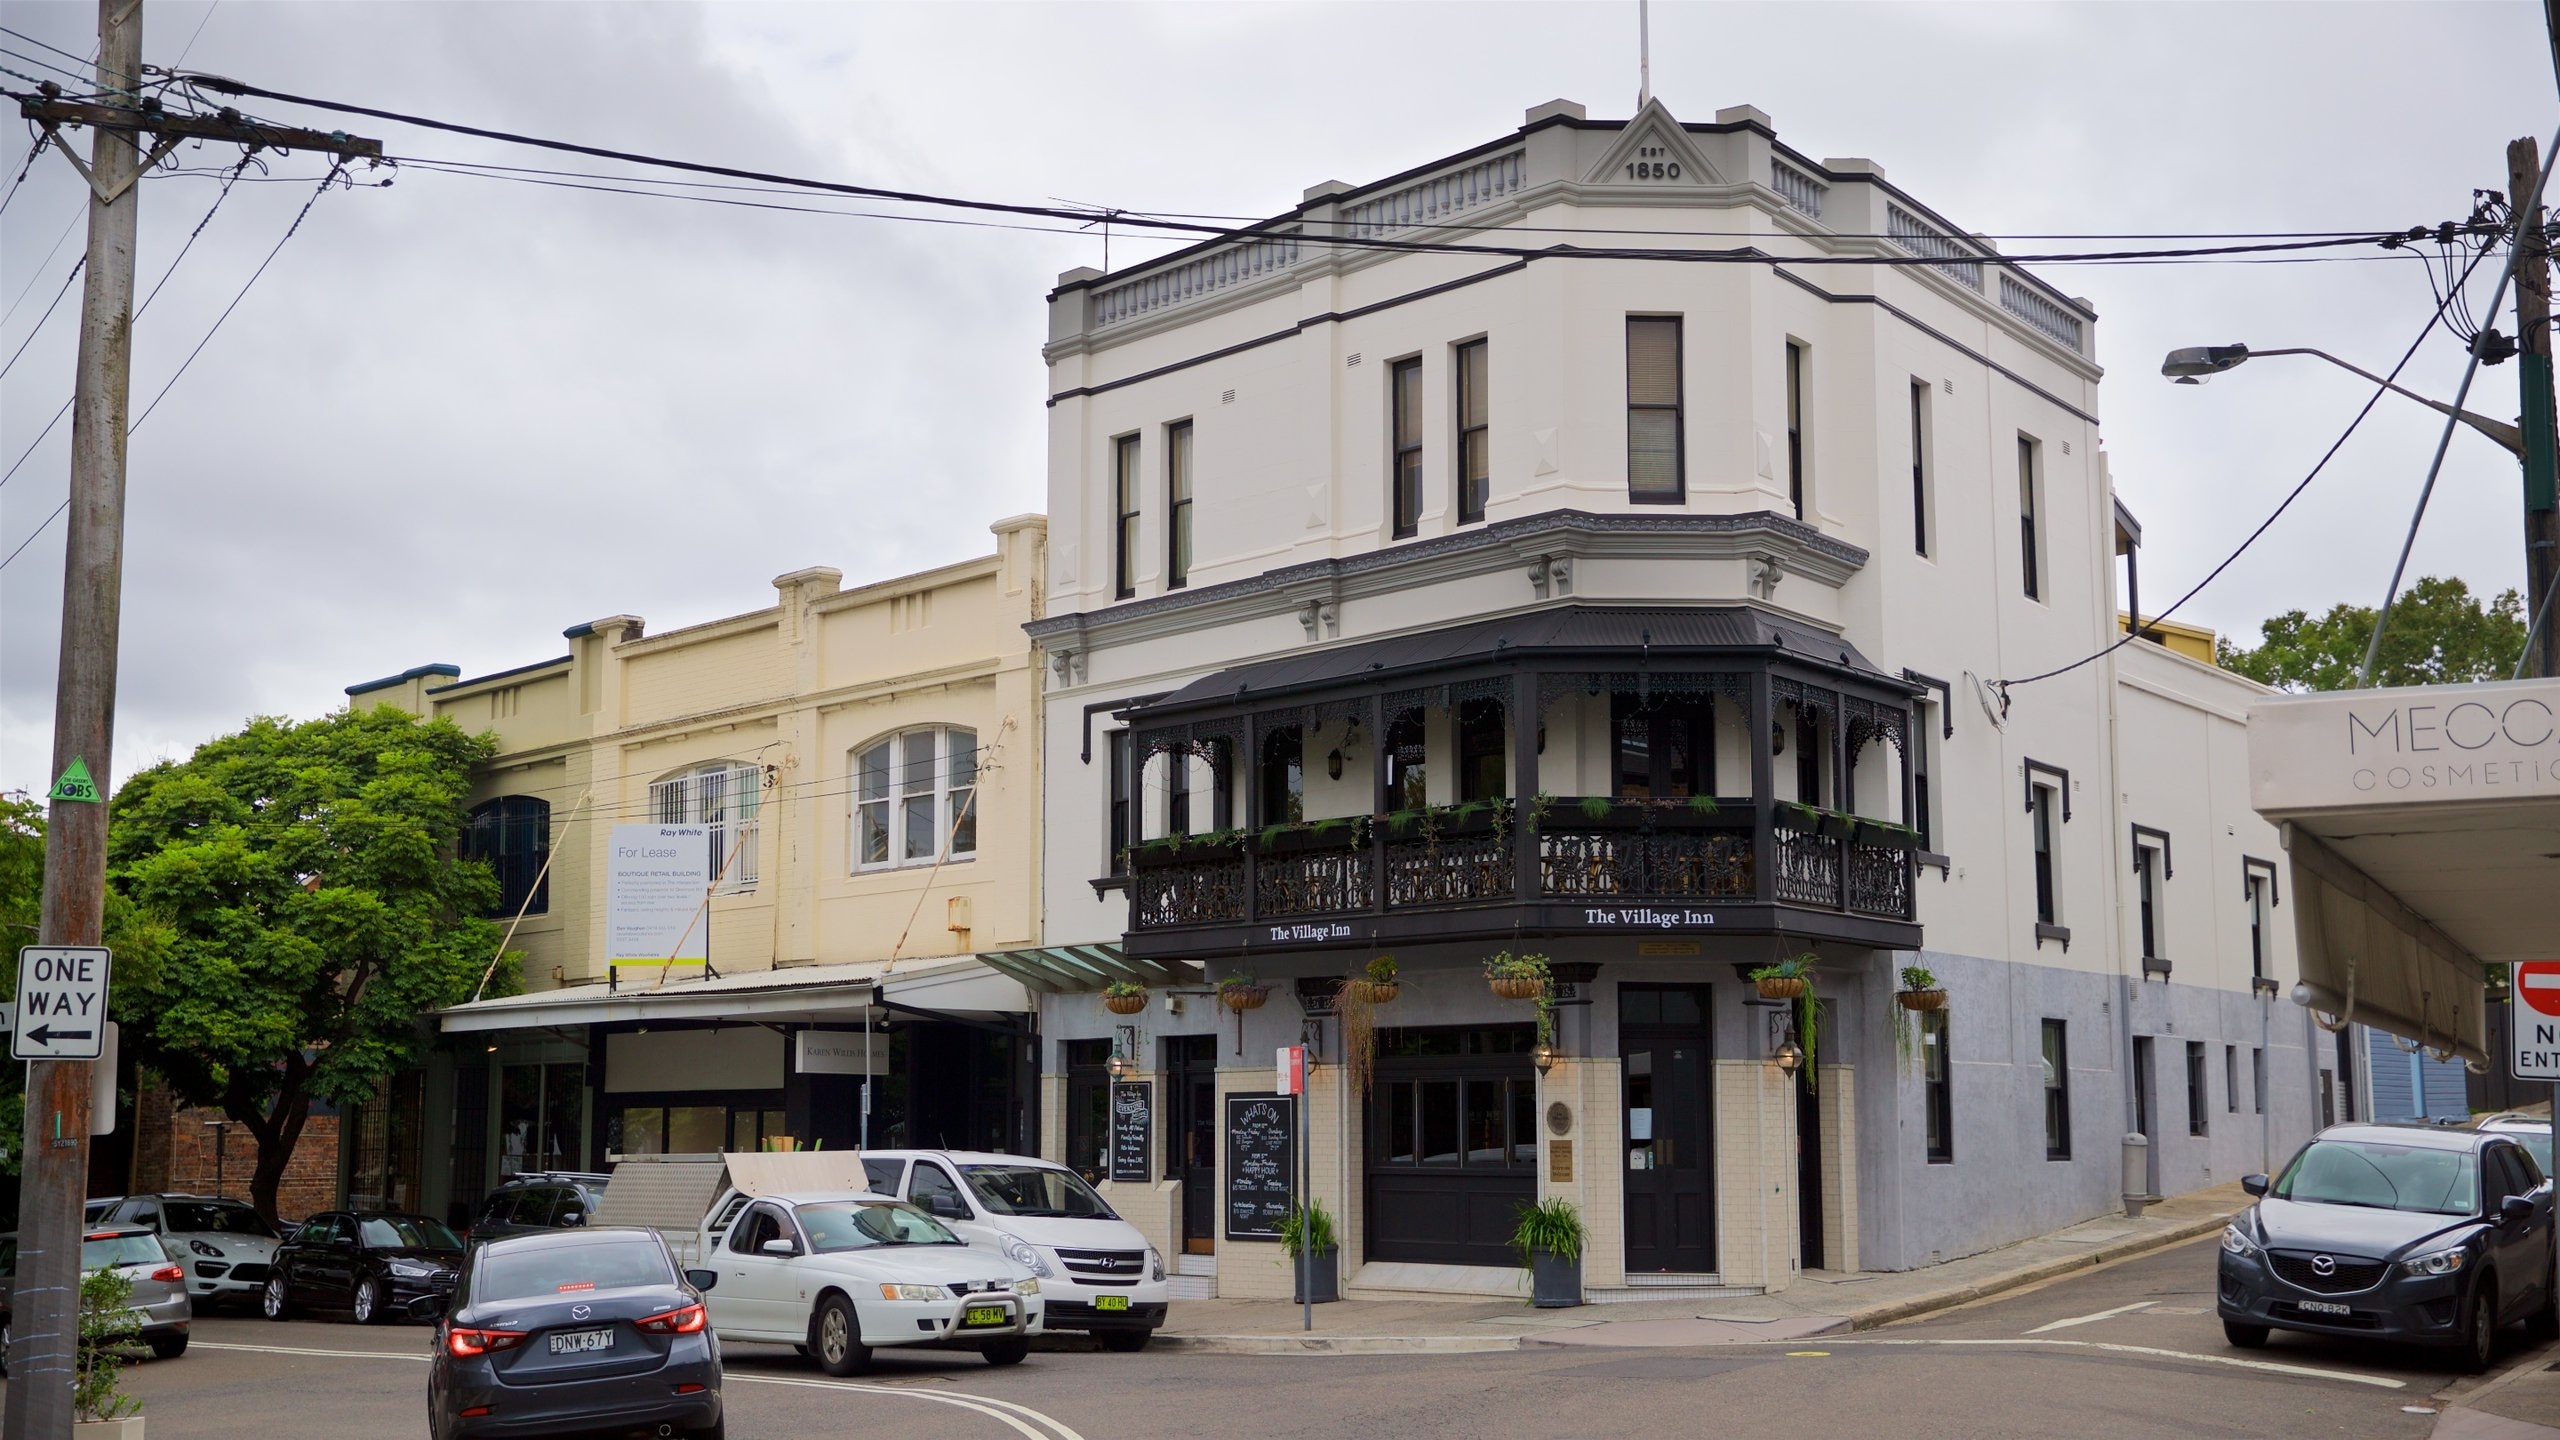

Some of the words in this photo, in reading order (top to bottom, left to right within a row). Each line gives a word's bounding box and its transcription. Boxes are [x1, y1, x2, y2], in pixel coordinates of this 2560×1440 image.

[1641, 147, 1665, 157] EST
[1626, 162, 1681, 179] 1850
[2349, 699, 2560, 755] MECC
[56, 783, 92, 798] JOBS
[660, 828, 676, 837] Ray
[678, 828, 702, 836] White
[618, 847, 638, 858] For
[642, 847, 677, 858] Lease
[1585, 908, 1616, 924] The
[1620, 908, 1680, 928] Village
[1684, 910, 1714, 924] Inn
[1270, 926, 1289, 941] The
[1291, 924, 1329, 942] Village
[1331, 923, 1351, 937] Inn
[35, 957, 94, 982] ONE
[28, 992, 96, 1016] WAY
[2537, 1024, 2560, 1044] N
[807, 1047, 831, 1056] KAREN
[1267, 1107, 1279, 1124] ON
[1098, 1297, 1105, 1307] BY
[1108, 1298, 1116, 1307] 40
[1118, 1297, 1126, 1307] HU
[968, 1310, 978, 1321] CC
[980, 1309, 990, 1320] 58
[993, 1308, 1003, 1319] MV
